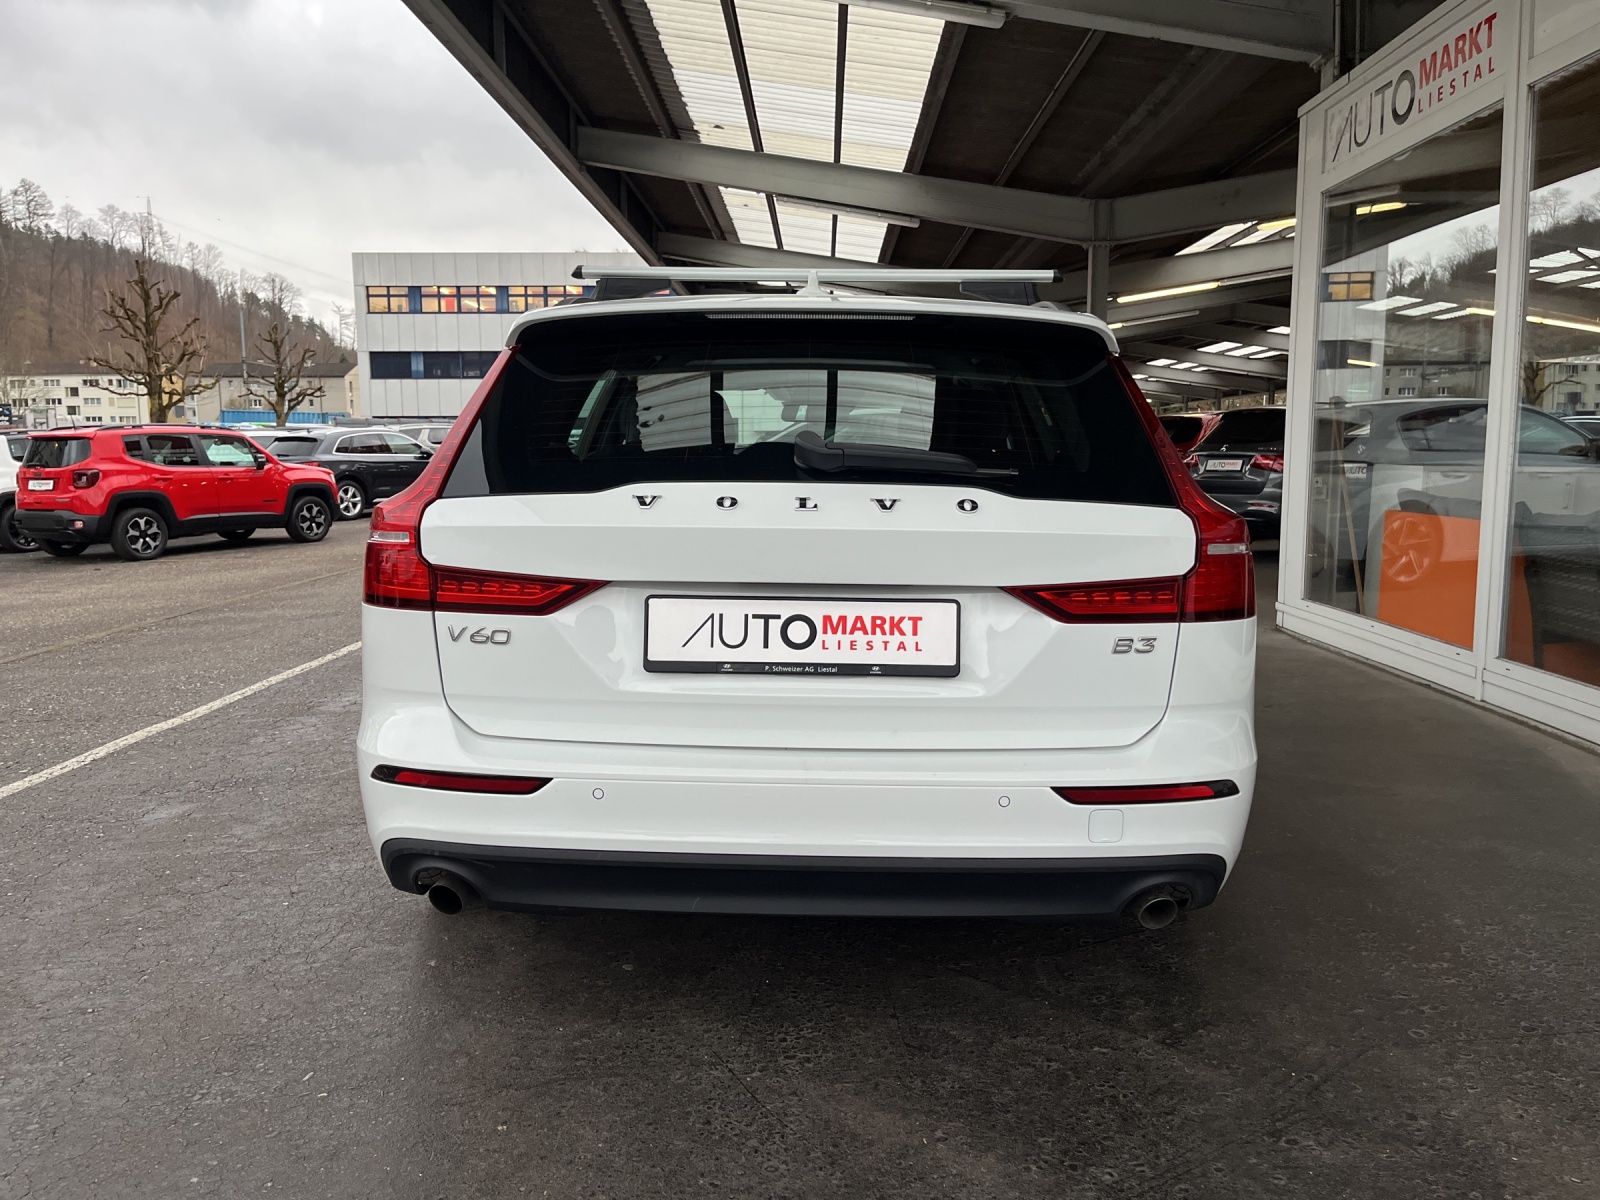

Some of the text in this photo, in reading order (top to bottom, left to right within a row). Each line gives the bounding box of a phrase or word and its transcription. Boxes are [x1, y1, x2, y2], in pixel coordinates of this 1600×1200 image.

[1332, 12, 1497, 162] AUTO MARKT
[1418, 57, 1495, 114] LIESTAL
[632, 494, 979, 514] VOLVO
[447, 624, 511, 645] V60
[681, 612, 923, 651] AUTO MARKT
[822, 639, 923, 652] LIESTAL
[1111, 636, 1157, 654] B3
